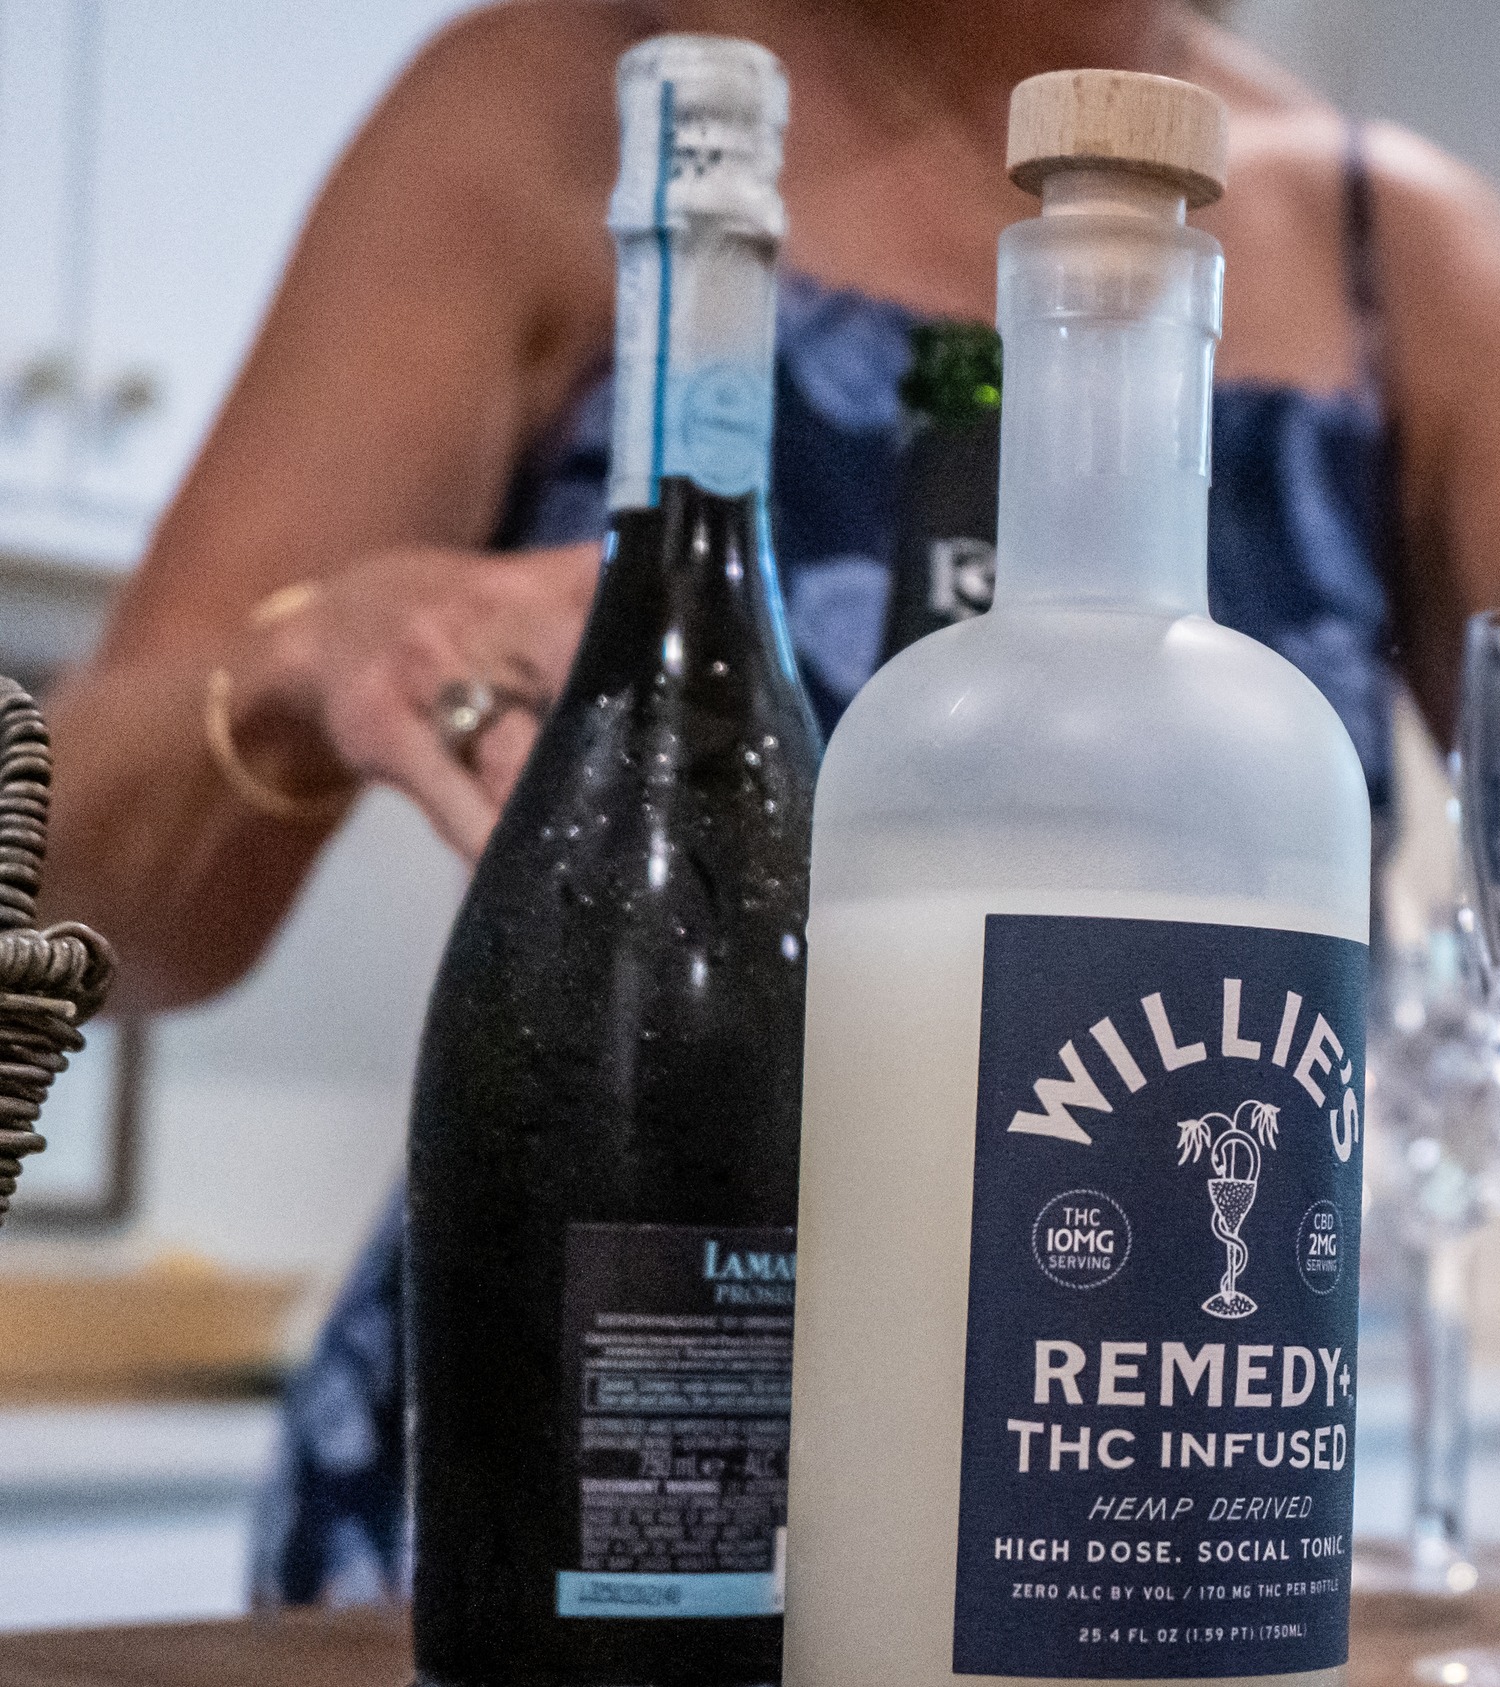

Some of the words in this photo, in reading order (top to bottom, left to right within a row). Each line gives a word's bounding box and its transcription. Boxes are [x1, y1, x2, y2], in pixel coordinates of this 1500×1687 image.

[1007, 978, 1358, 1162] WILLIE'S
[1064, 1207, 1100, 1226] THC
[1314, 1213, 1333, 1230] CBD
[1047, 1228, 1113, 1253] 10MG
[1309, 1233, 1336, 1255] 2MG
[1049, 1255, 1110, 1270] SERVING
[1307, 1259, 1337, 1271] SERVING
[1007, 1419, 1135, 1472] THC
[1161, 1424, 1346, 1471] INFUSED
[1088, 1496, 1193, 1520] HEMP
[1209, 1496, 1312, 1520] DERIVED
[995, 1538, 1069, 1561] HIGH
[1087, 1541, 1180, 1563] DOSE.
[1198, 1540, 1289, 1562] SOCIAL
[1301, 1535, 1344, 1558] TONIC.
[1012, 1583, 1058, 1598] ZERO
[1067, 1586, 1101, 1600] ALC
[1111, 1586, 1132, 1599] BY
[1143, 1586, 1174, 1600] VOL
[1200, 1586, 1225, 1599] 170
[1233, 1586, 1250, 1598] MG
[1259, 1584, 1281, 1597] THC
[1287, 1582, 1306, 1595] PER
[1310, 1578, 1338, 1594] BOTTLE
[1079, 1628, 1119, 1642] 25.4
[1129, 1629, 1147, 1642] FL
[1158, 1629, 1177, 1642] OZ
